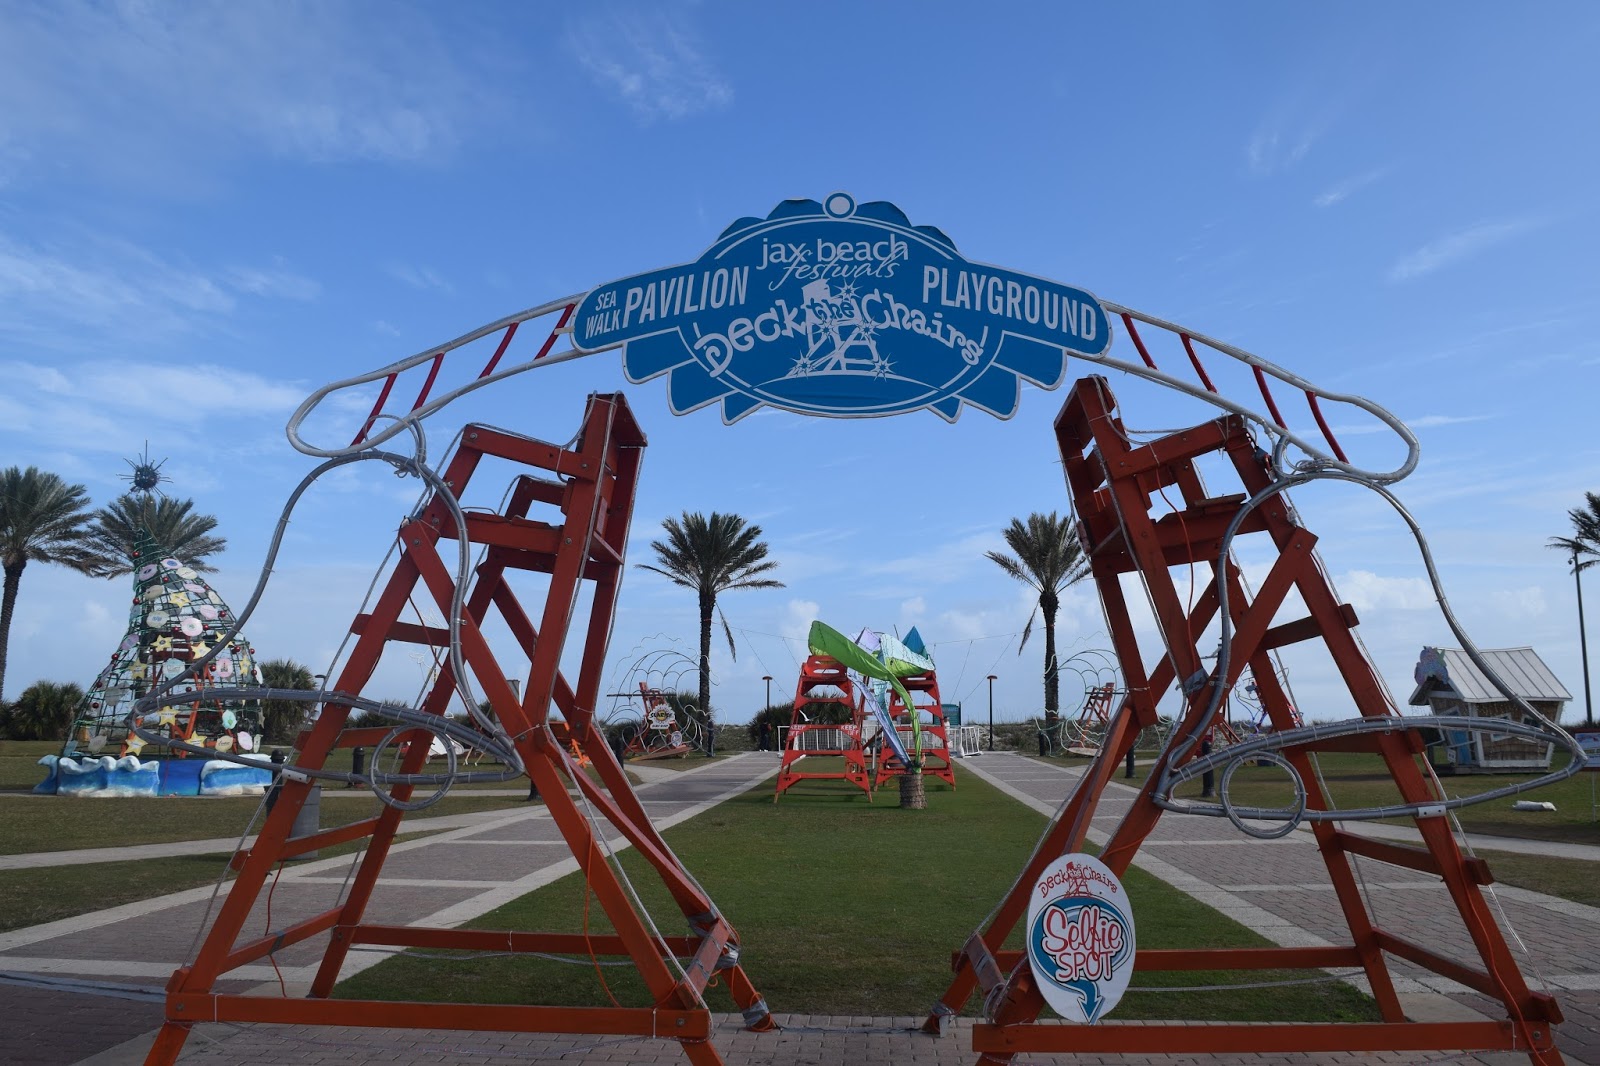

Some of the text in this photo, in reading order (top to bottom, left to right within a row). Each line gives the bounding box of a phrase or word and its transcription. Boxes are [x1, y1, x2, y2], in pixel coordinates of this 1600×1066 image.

[756, 233, 909, 270] jax beach
[768, 244, 908, 291] festivals
[595, 290, 617, 312] SEA
[622, 266, 749, 329] PAVILION
[922, 265, 1097, 341] PLAYGROUND
[585, 309, 622, 340] WALK
[693, 288, 984, 378] Deck the Chairs
[1038, 865, 1118, 898] Deck Chairs
[1044, 908, 1121, 962] Selfie
[1058, 951, 1114, 979] SPOT
